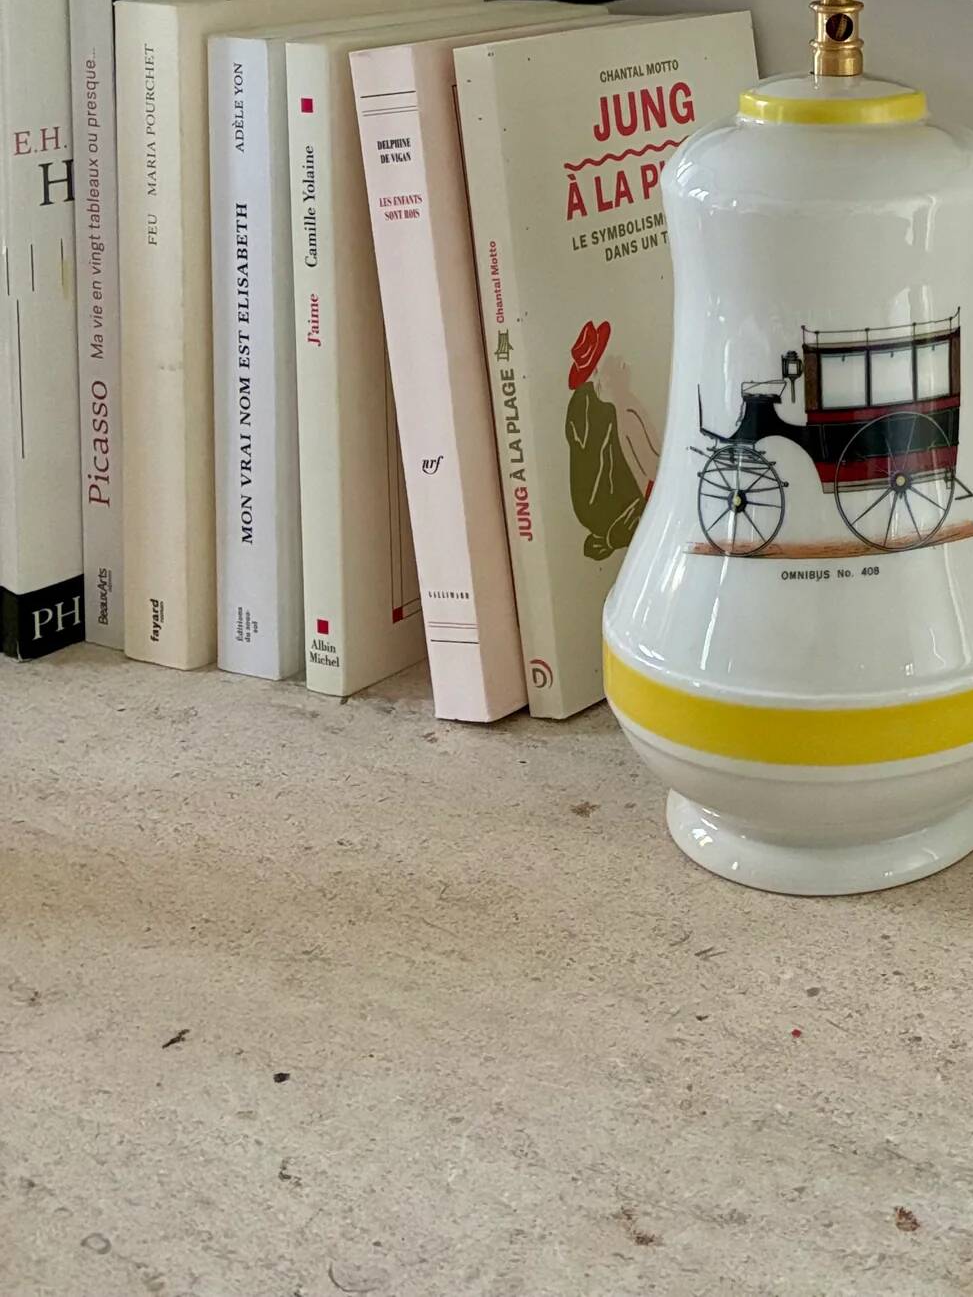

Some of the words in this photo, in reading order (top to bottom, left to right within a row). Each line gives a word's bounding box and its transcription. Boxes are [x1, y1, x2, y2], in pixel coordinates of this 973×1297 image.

[145, 44, 155, 135] POURCHET
[233, 62, 242, 96] YON
[600, 66, 644, 82] CHANTAL
[646, 59, 679, 76] MOTTO
[232, 100, 244, 152] ADÈLE
[593, 82, 695, 142] JUNG
[88, 133, 98, 152] ou
[381, 154, 389, 163] DE
[147, 140, 156, 195] MARIA
[302, 145, 315, 202] Yolaine
[87, 159, 101, 230] tableaux
[379, 198, 391, 207] LES
[566, 174, 587, 221] À
[594, 170, 634, 212] LA
[640, 160, 665, 200] P
[148, 214, 157, 245] FEU
[304, 208, 316, 267] Camille
[572, 234, 588, 251] LE
[591, 212, 667, 245] SYMBOLISM
[604, 241, 638, 261] DANS
[642, 234, 658, 249] UN
[89, 234, 104, 276] vingt
[236, 203, 249, 323] ELISABETH
[489, 241, 500, 275] Motto
[92, 280, 102, 300] en
[493, 277, 504, 323] Chantal
[91, 304, 103, 329] vie
[91, 333, 104, 360] Ma
[239, 330, 250, 369] EST
[240, 377, 250, 427] NOM
[501, 369, 520, 434] PLAGE
[88, 381, 110, 507] Picasso
[240, 434, 252, 488] VRAI
[509, 440, 524, 464] LA
[422, 455, 443, 475] nrf
[509, 468, 526, 482] À
[241, 496, 252, 544] MON
[514, 487, 532, 541] JUNG
[781, 570, 830, 582] OMNIBUS
[862, 566, 879, 575] 408
[150, 599, 160, 642] fayard
[309, 651, 340, 667] Michel
[310, 639, 336, 654] Albin
